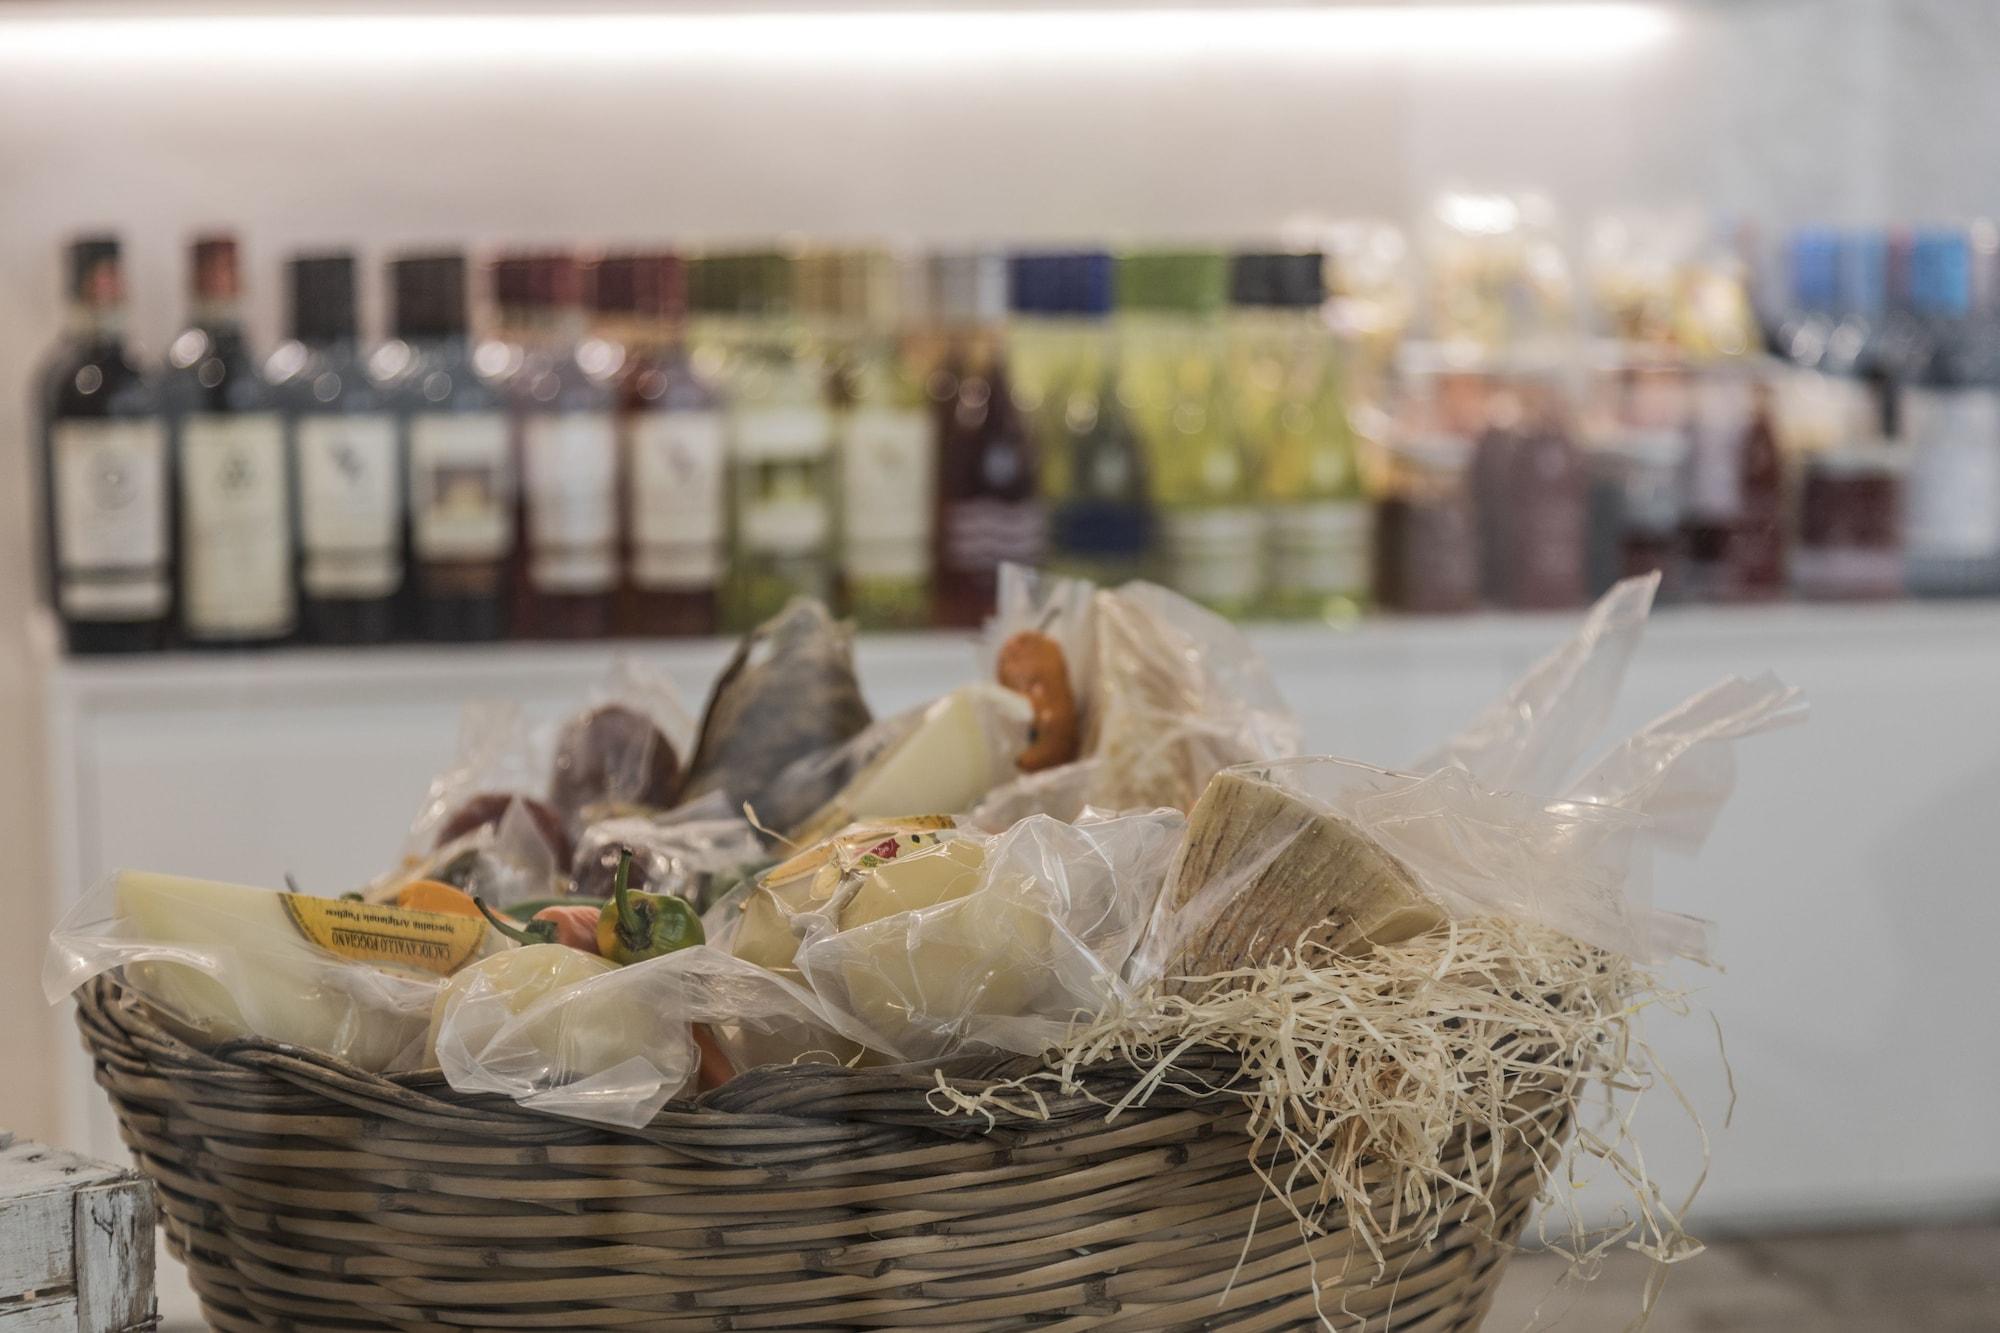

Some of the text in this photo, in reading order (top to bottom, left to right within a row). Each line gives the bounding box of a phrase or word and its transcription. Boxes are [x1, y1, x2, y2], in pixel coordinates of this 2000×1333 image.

[325, 910, 360, 922] Pugliese
[363, 914, 409, 929] Artigianale
[332, 932, 450, 960] CACIOCAVALLO FOGGIANO
